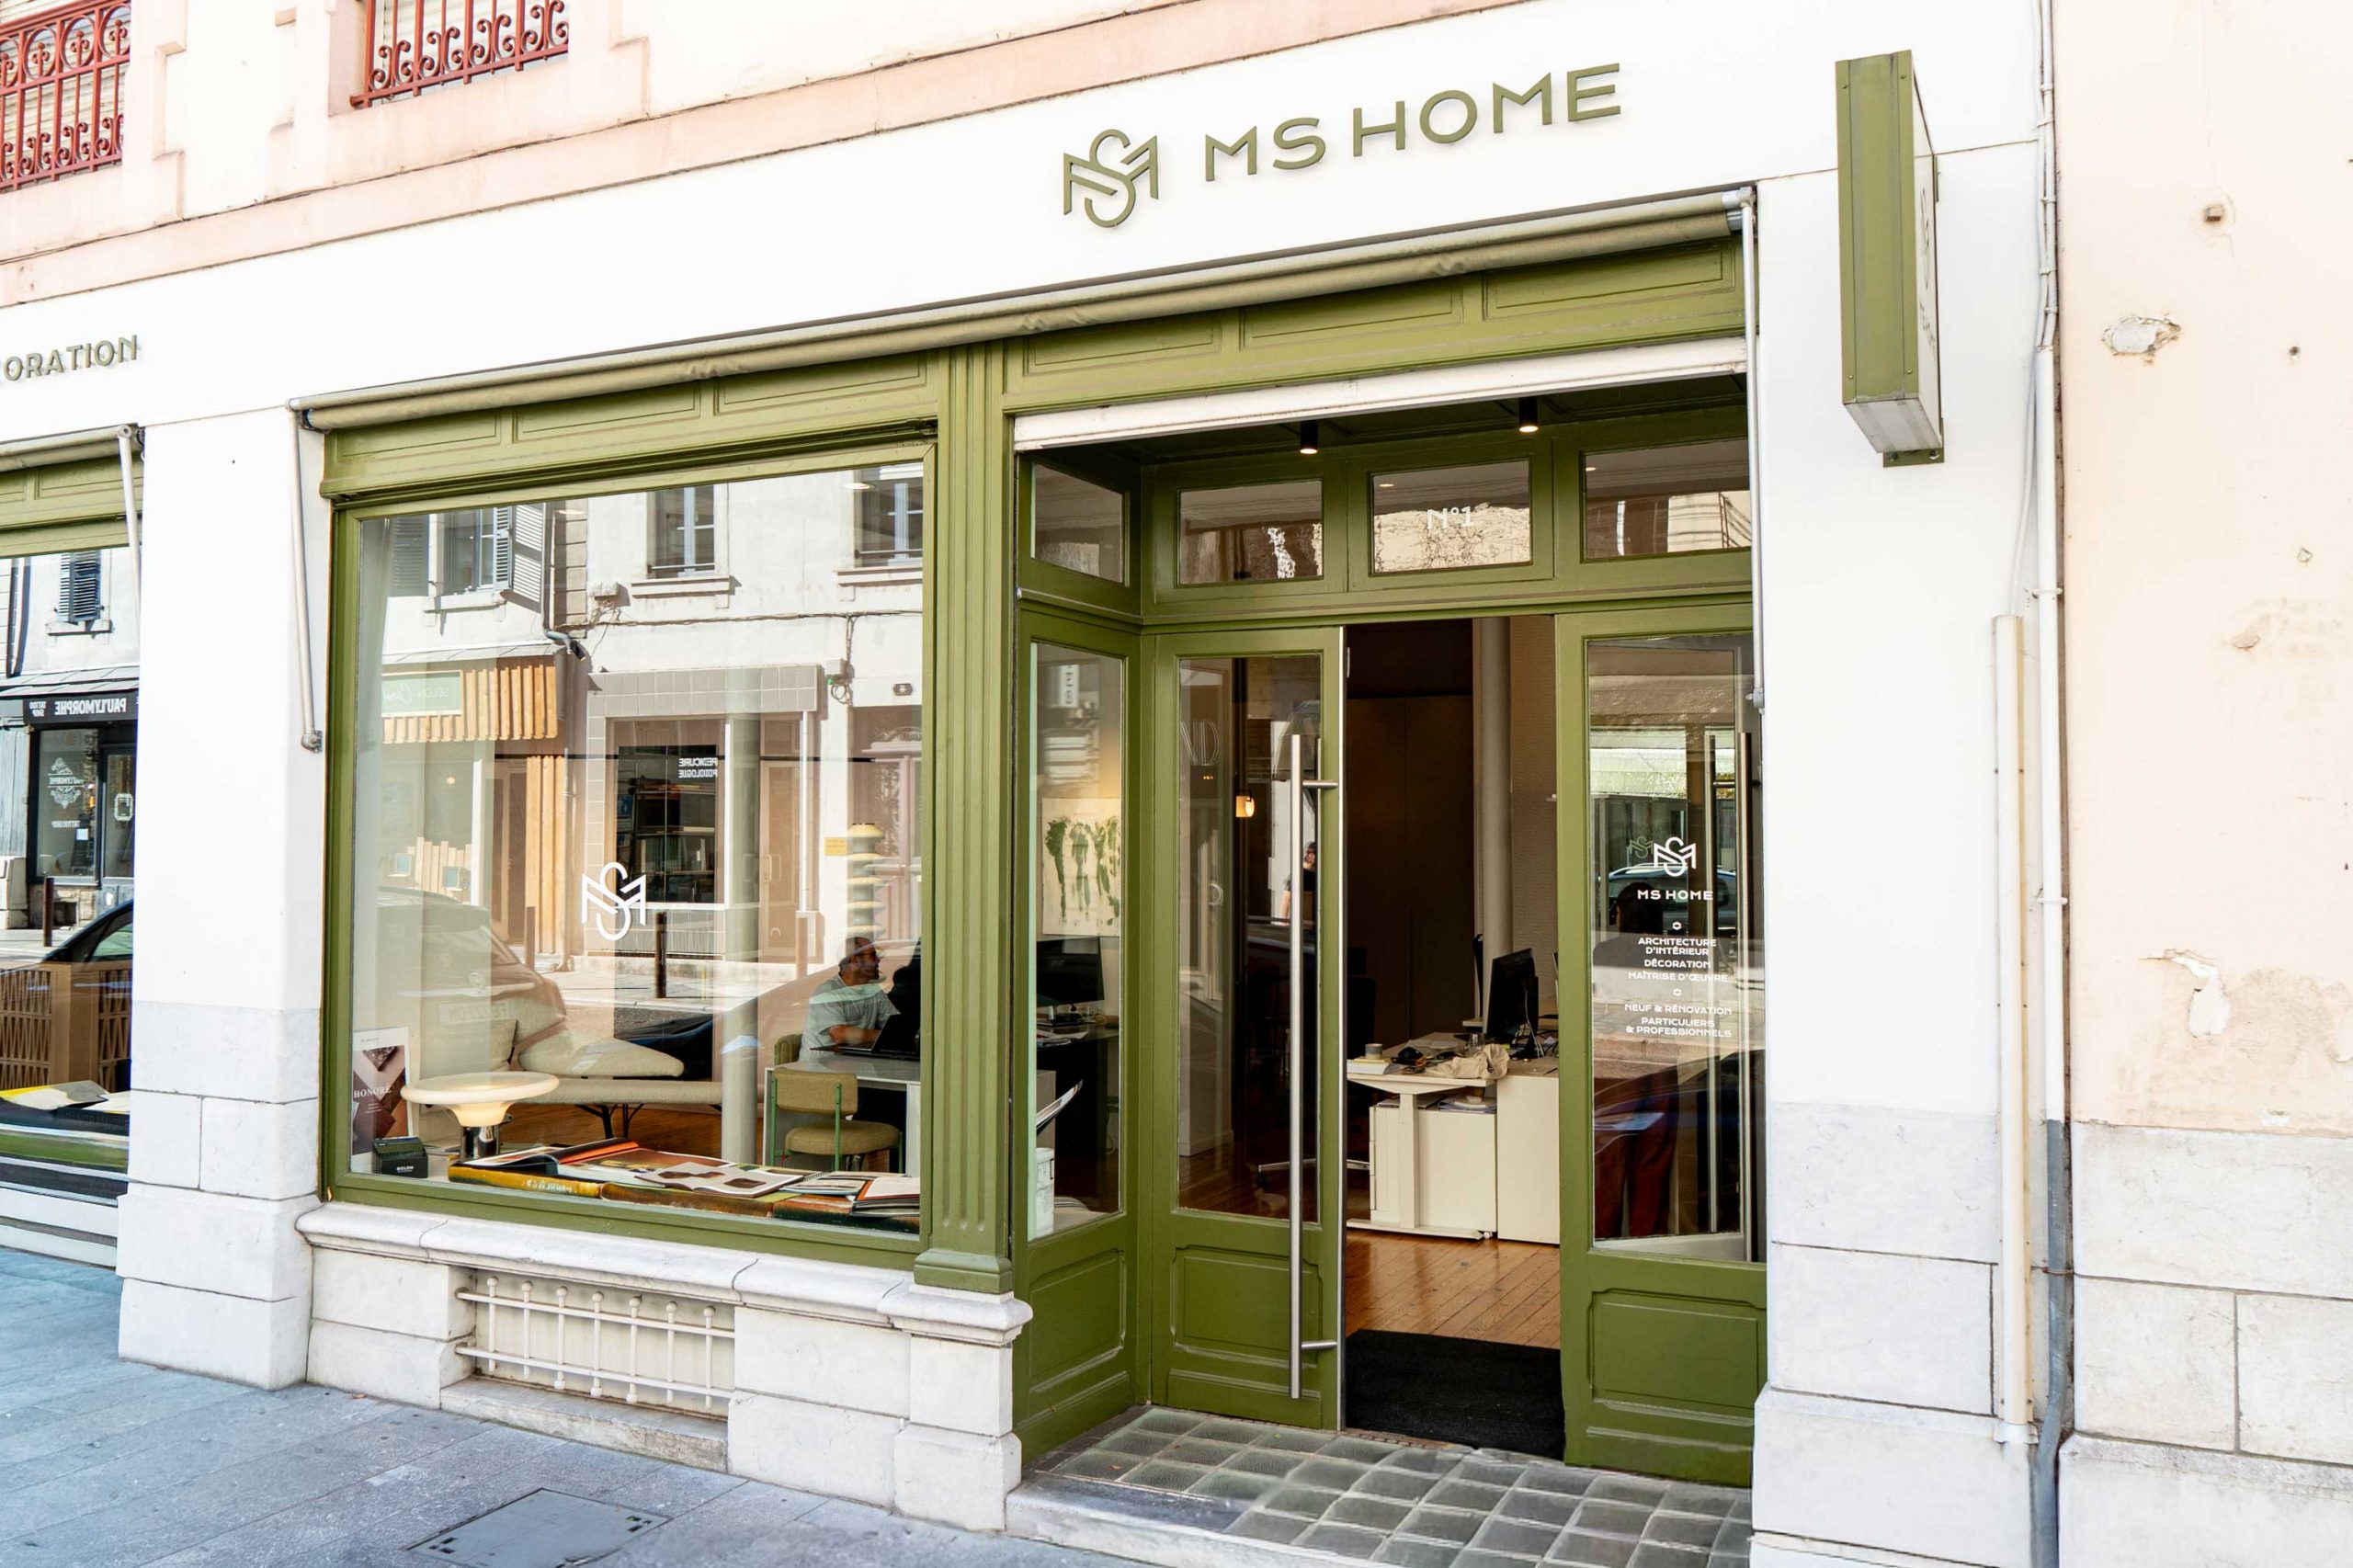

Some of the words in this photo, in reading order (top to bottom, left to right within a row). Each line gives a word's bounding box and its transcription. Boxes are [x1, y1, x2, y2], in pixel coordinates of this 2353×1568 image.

[1205, 117, 1326, 182] MS
[1353, 62, 1621, 157] HOME
[2, 335, 138, 381] ORATION
[1637, 889, 1661, 900] MS
[1665, 889, 1713, 901] HOME
[1638, 937, 1717, 947] ARCHITECTURE
[1643, 958, 1711, 969] DÉCORATION
[1624, 1004, 1652, 1012] NEUF
[1654, 1005, 1663, 1013] &
[1641, 1017, 1715, 1028] PARTICULIERS
[1636, 1026, 1732, 1038] PROFESSIONNELS
